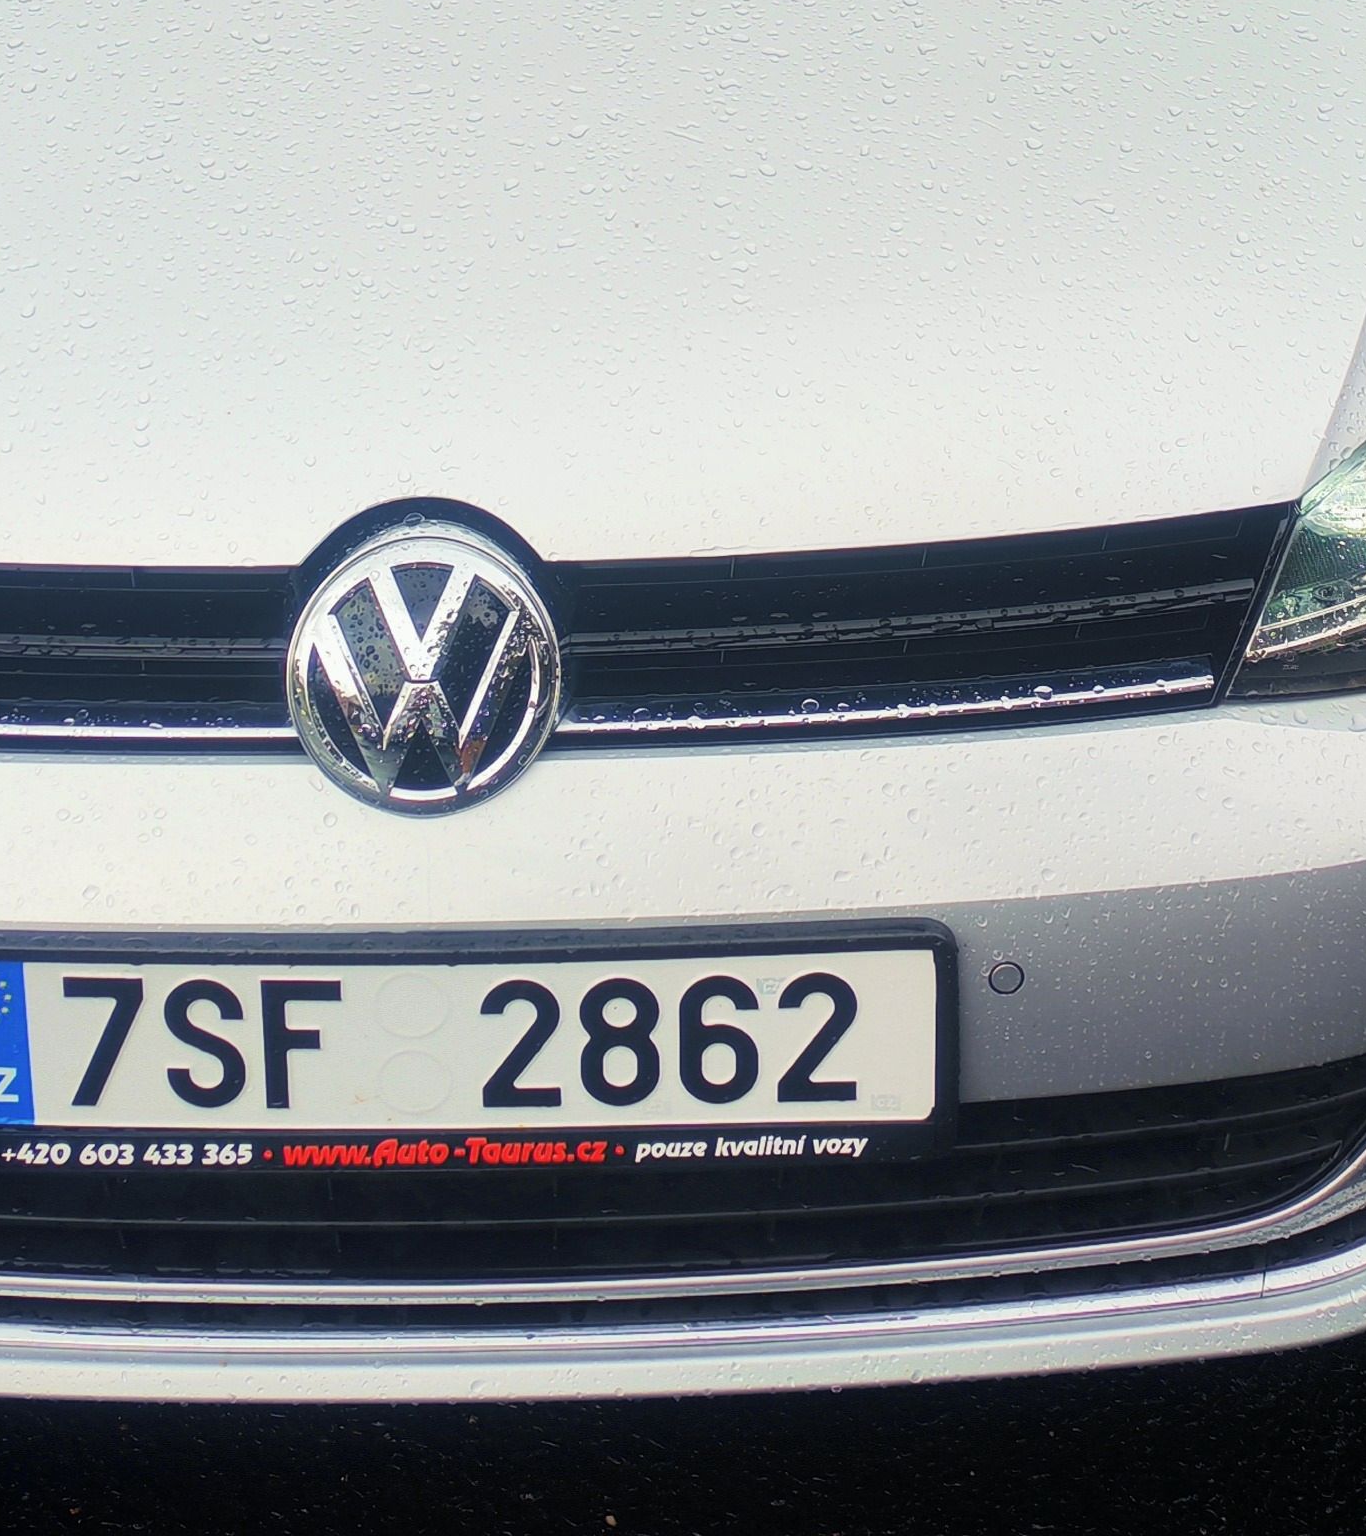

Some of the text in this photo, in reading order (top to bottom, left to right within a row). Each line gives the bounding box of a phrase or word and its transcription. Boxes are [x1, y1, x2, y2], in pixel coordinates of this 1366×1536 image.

[62, 972, 858, 1109] 7SF 2862
[1, 1142, 72, 1165] +420
[79, 1144, 134, 1165] 603
[143, 1144, 194, 1165] 433
[202, 1144, 253, 1165] 365
[635, 1142, 708, 1163] pouze
[715, 1135, 807, 1157] kvalitní
[812, 1137, 868, 1158] vozy
